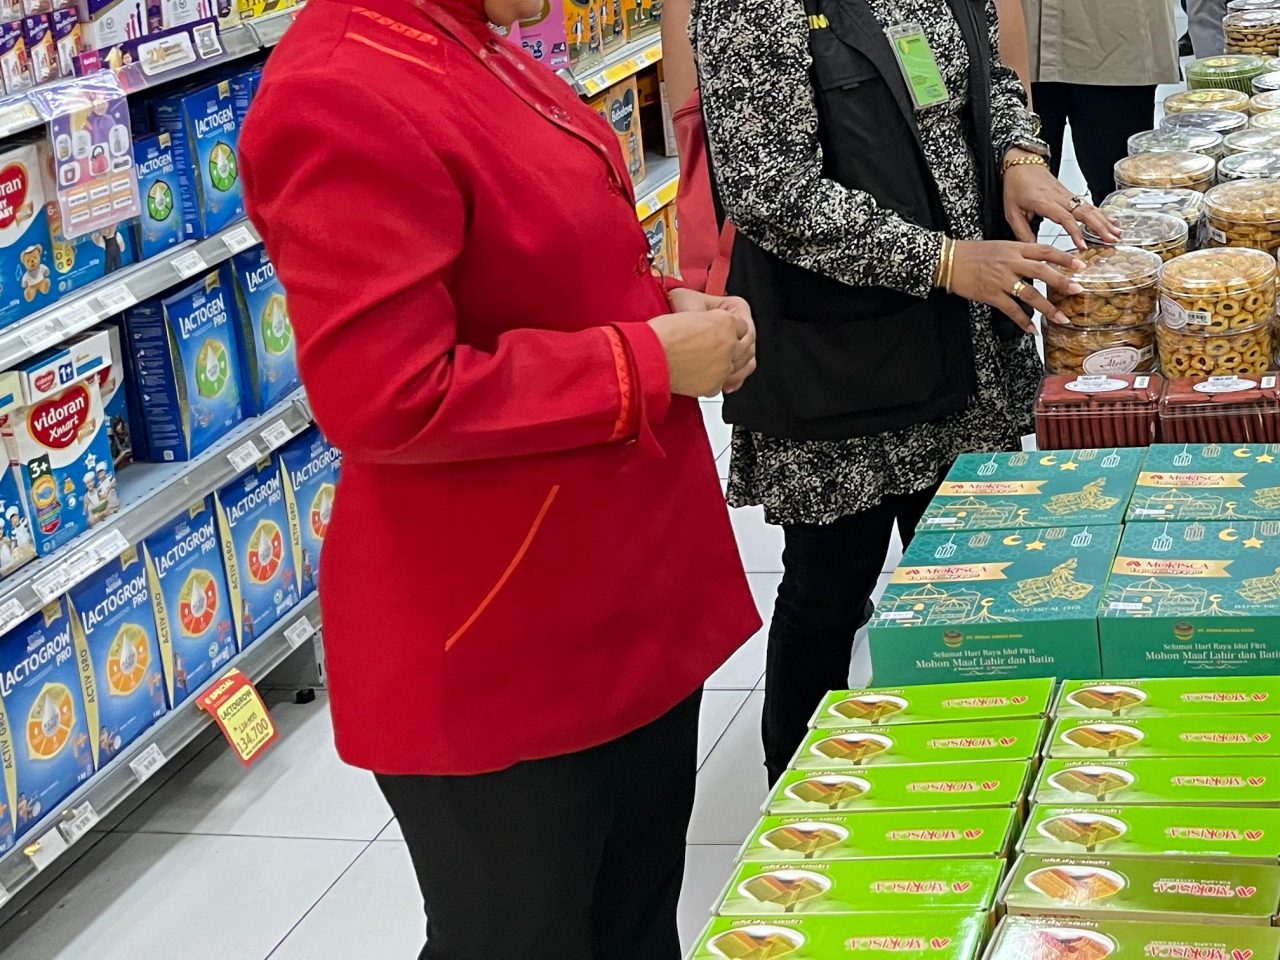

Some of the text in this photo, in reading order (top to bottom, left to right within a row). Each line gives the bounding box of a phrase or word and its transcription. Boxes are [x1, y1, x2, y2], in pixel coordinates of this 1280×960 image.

[194, 105, 235, 139] LACTOGEN
[223, 120, 236, 132] PRO
[136, 150, 173, 179] LACTOGEN
[179, 292, 225, 339] LACTOGEN
[212, 312, 227, 327] PRO
[33, 394, 86, 432] vidoran
[226, 468, 280, 527] LACTOGROW
[268, 489, 282, 505] PRO
[155, 517, 215, 578] LACTOGROW
[201, 538, 216, 555] PRO
[82, 568, 147, 633] LACTOGROW
[132, 590, 148, 606] PRO
[56, 647, 72, 667] PRO
[916, 655, 1055, 669] Mohon Maaf Lahir dan Batin
[1145, 651, 1180, 660] Mohon
[1182, 651, 1207, 660] Maaf
[1209, 650, 1235, 659] Lahir
[1238, 650, 1256, 659] dan
